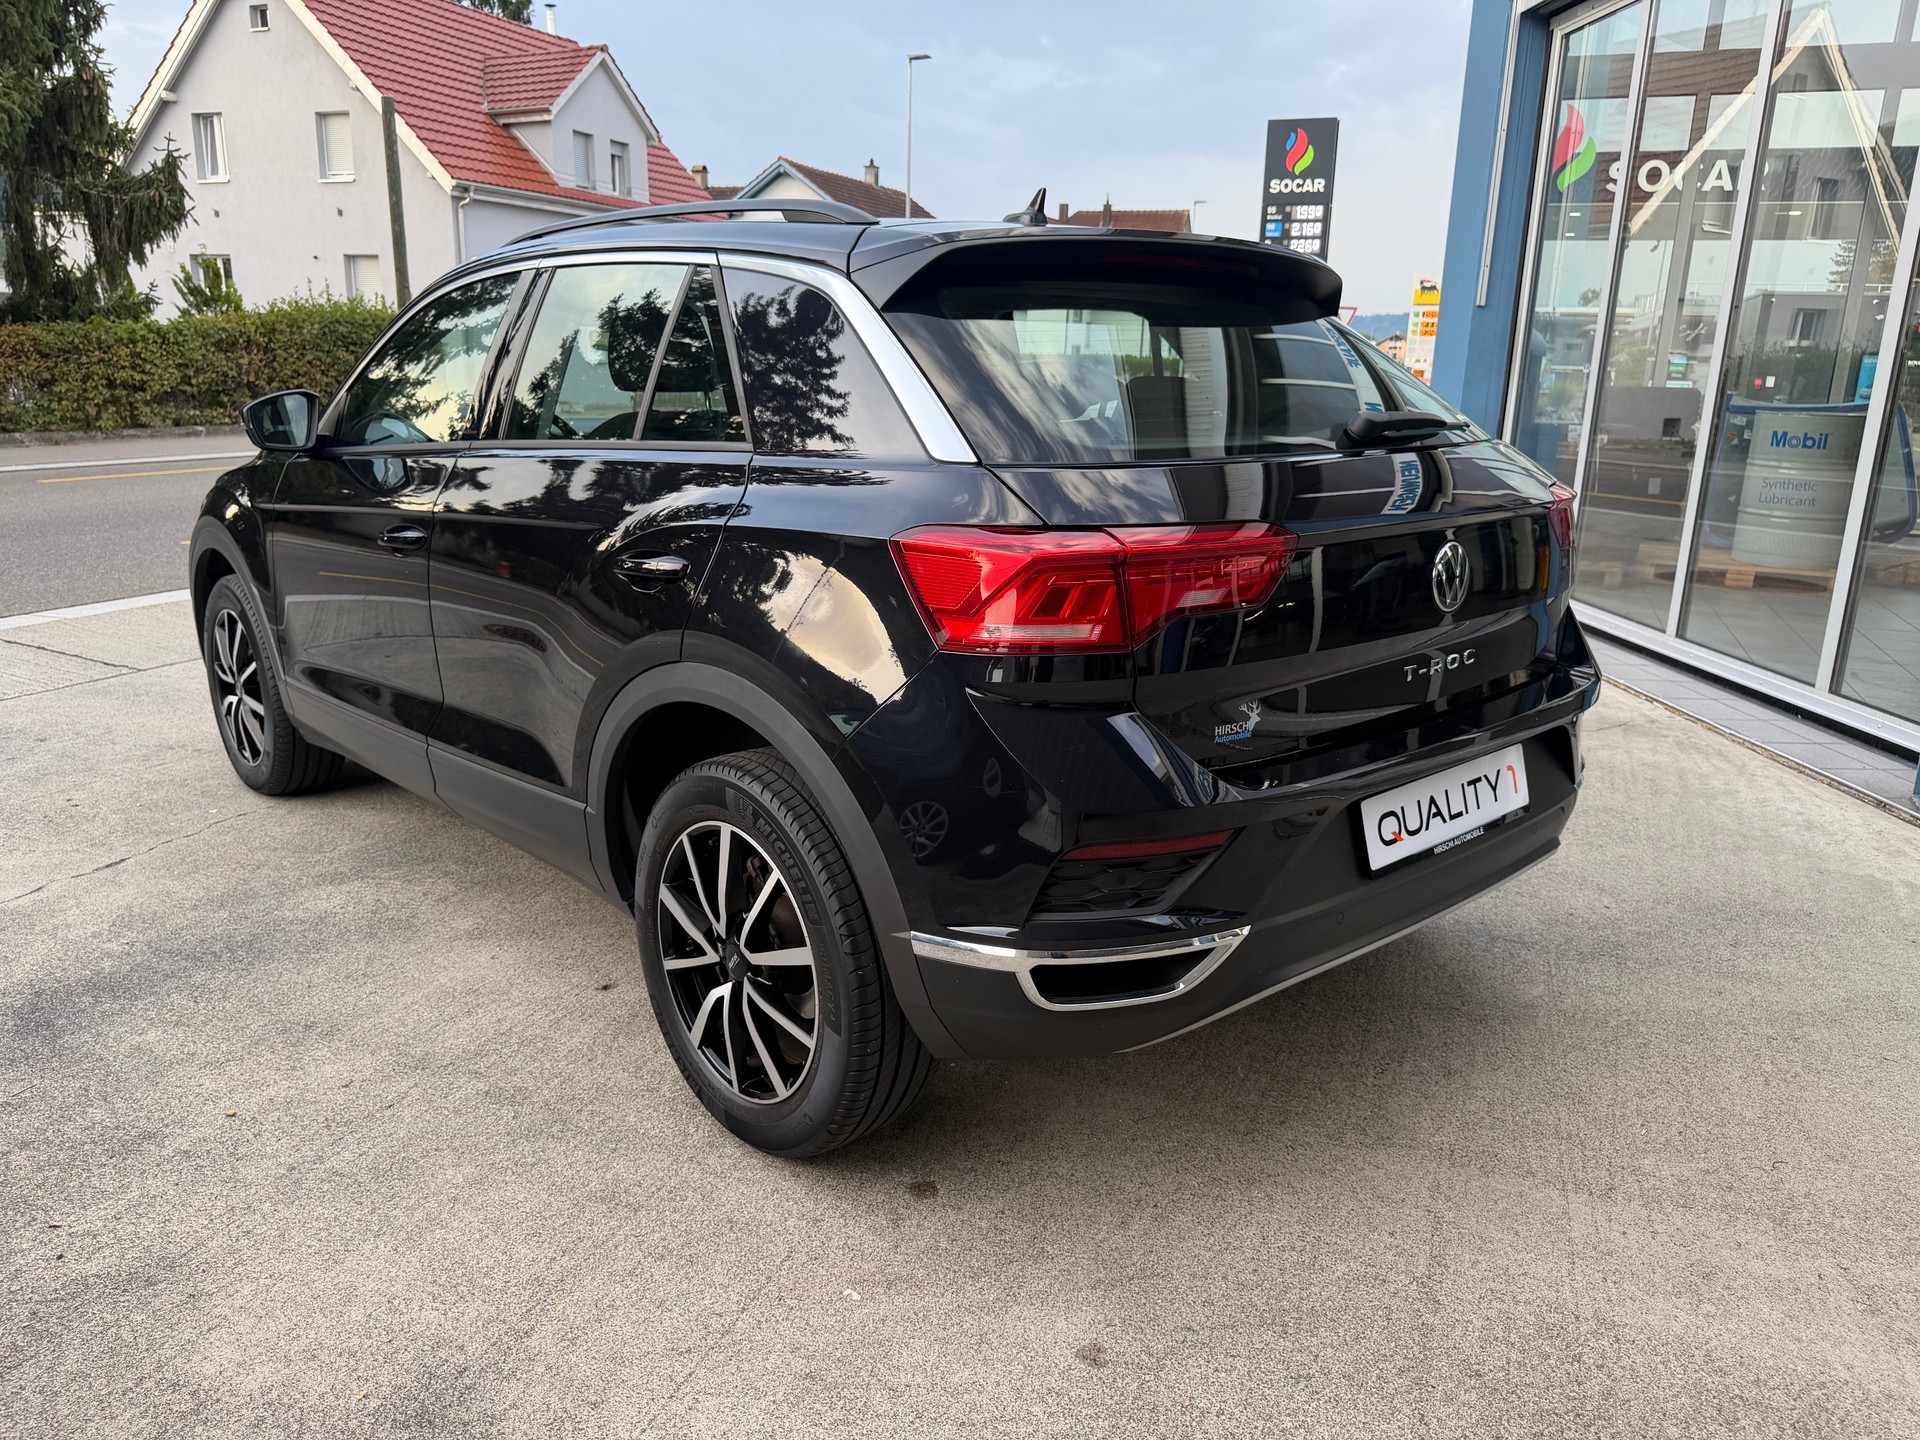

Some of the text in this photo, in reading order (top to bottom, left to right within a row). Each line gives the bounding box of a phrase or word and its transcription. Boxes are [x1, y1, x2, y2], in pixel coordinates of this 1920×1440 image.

[1269, 178, 1325, 193] SOCAR
[1770, 430, 1829, 449] Mobil
[1761, 478, 1818, 492] Synthetic
[1758, 493, 1817, 507] Lubricant
[1404, 648, 1476, 682] T-ROC
[1214, 731, 1252, 743] Automobile
[1377, 768, 1501, 847] QUALITY
[1454, 826, 1485, 846] AUTOMOBILE
[755, 817, 820, 920] MICHELIN
